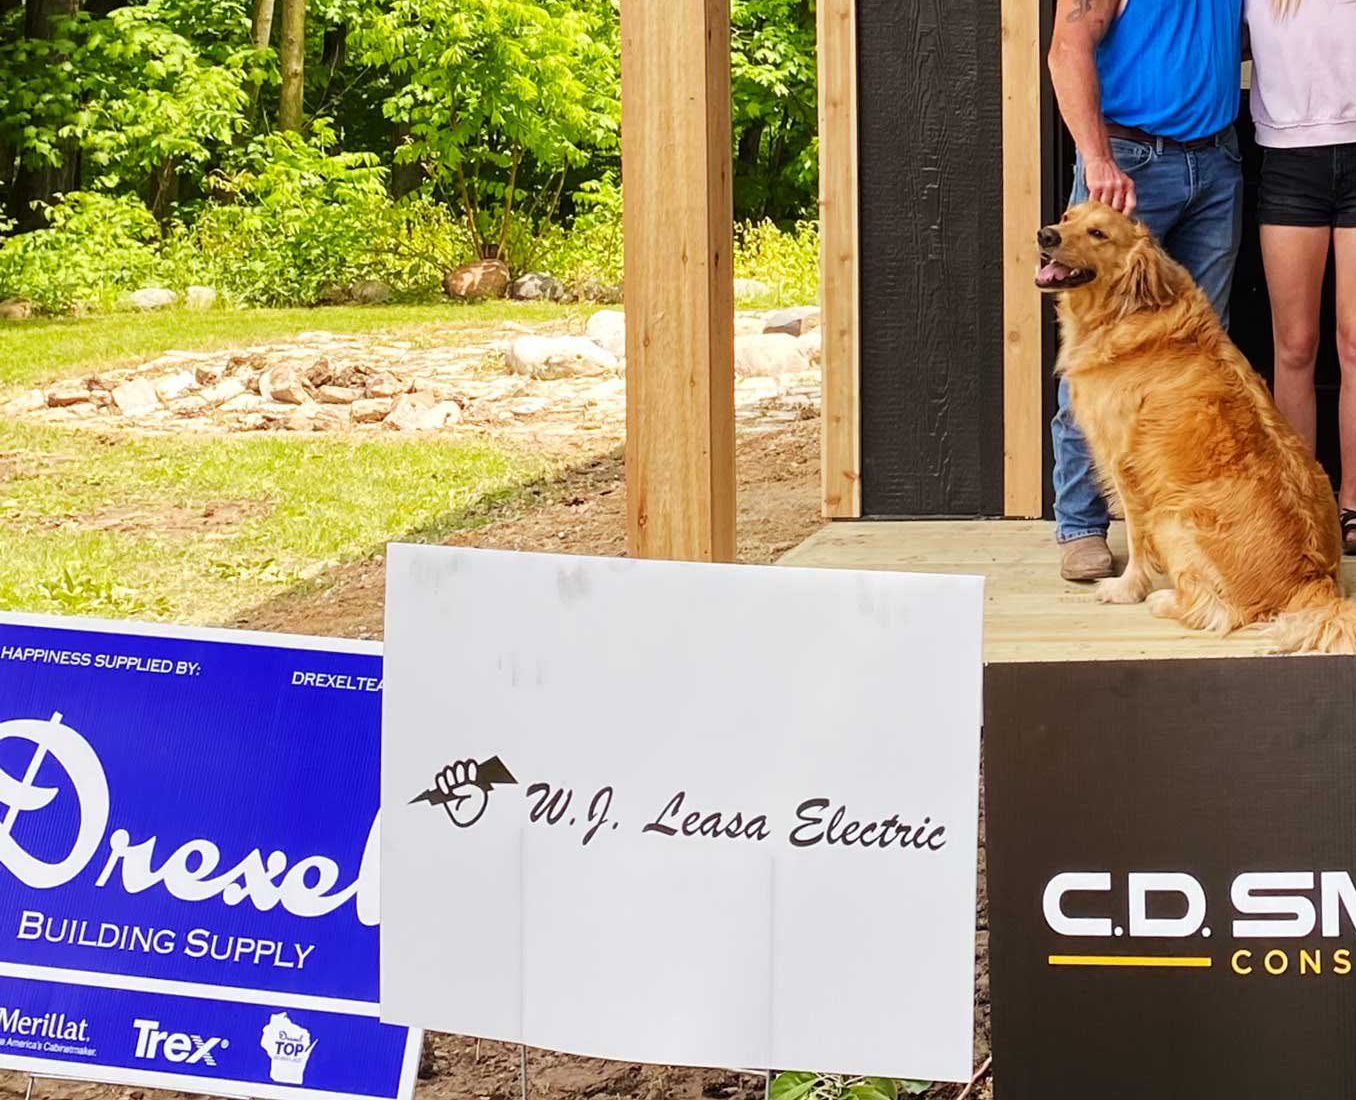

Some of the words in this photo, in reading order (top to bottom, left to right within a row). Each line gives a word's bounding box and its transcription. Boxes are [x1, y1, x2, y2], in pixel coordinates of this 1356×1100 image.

[0, 645, 92, 667] HAPPINESS
[93, 654, 173, 674] SUPPLIED
[175, 661, 202, 677] BY:
[642, 791, 771, 841] Leasa
[789, 798, 947, 852] Electric
[1042, 872, 1212, 938] C.D.
[16, 910, 176, 954] BUILDING
[183, 928, 315, 969] SUPPLY
[275, 1040, 304, 1057] TOP
